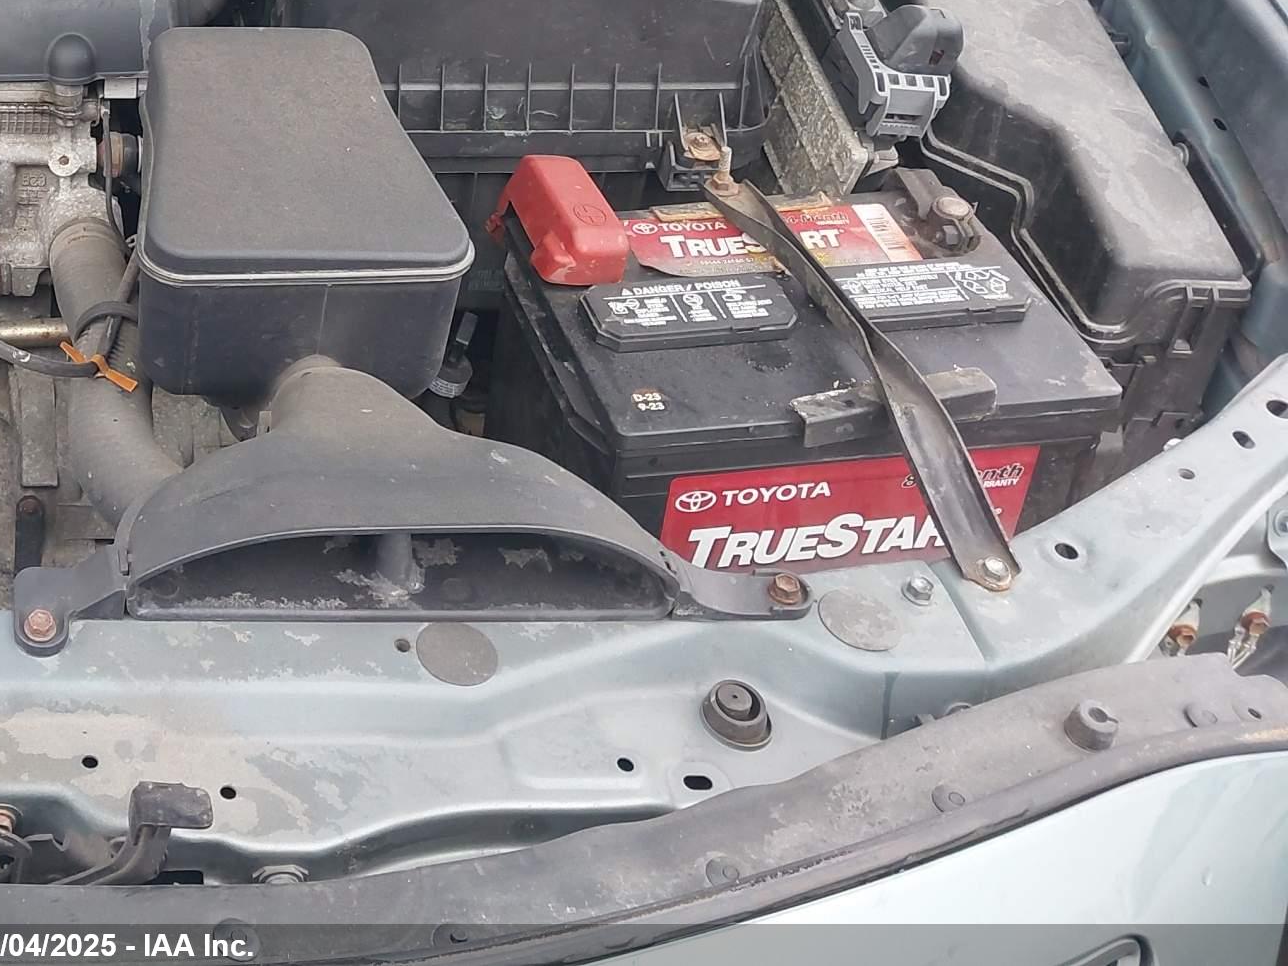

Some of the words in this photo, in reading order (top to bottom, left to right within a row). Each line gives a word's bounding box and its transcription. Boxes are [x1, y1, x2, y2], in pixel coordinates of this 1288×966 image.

[658, 221, 728, 233] TOYOTA
[633, 284, 683, 296] DANGER
[695, 280, 742, 291] POISON
[983, 477, 1019, 488] RRANTY
[722, 481, 831, 506] TOYOTA
